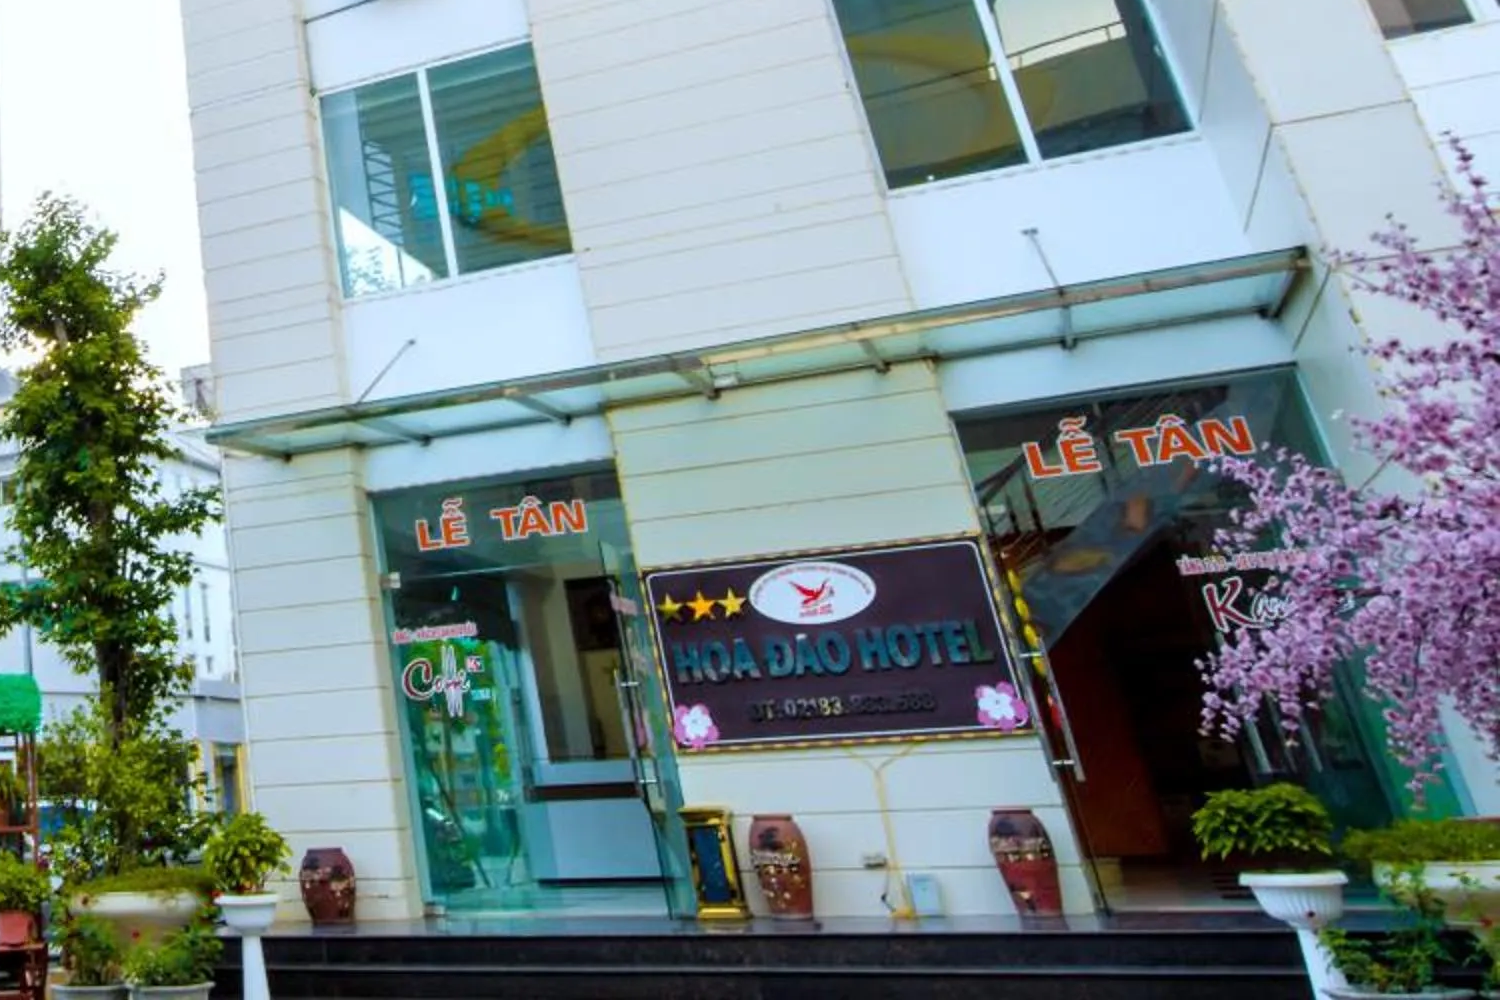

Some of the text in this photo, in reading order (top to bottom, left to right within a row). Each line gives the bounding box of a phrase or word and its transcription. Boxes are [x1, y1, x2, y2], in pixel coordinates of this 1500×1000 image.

[1115, 414, 1256, 467] TÂN
[490, 496, 588, 541] TÂN
[856, 619, 997, 670] HOTEL
